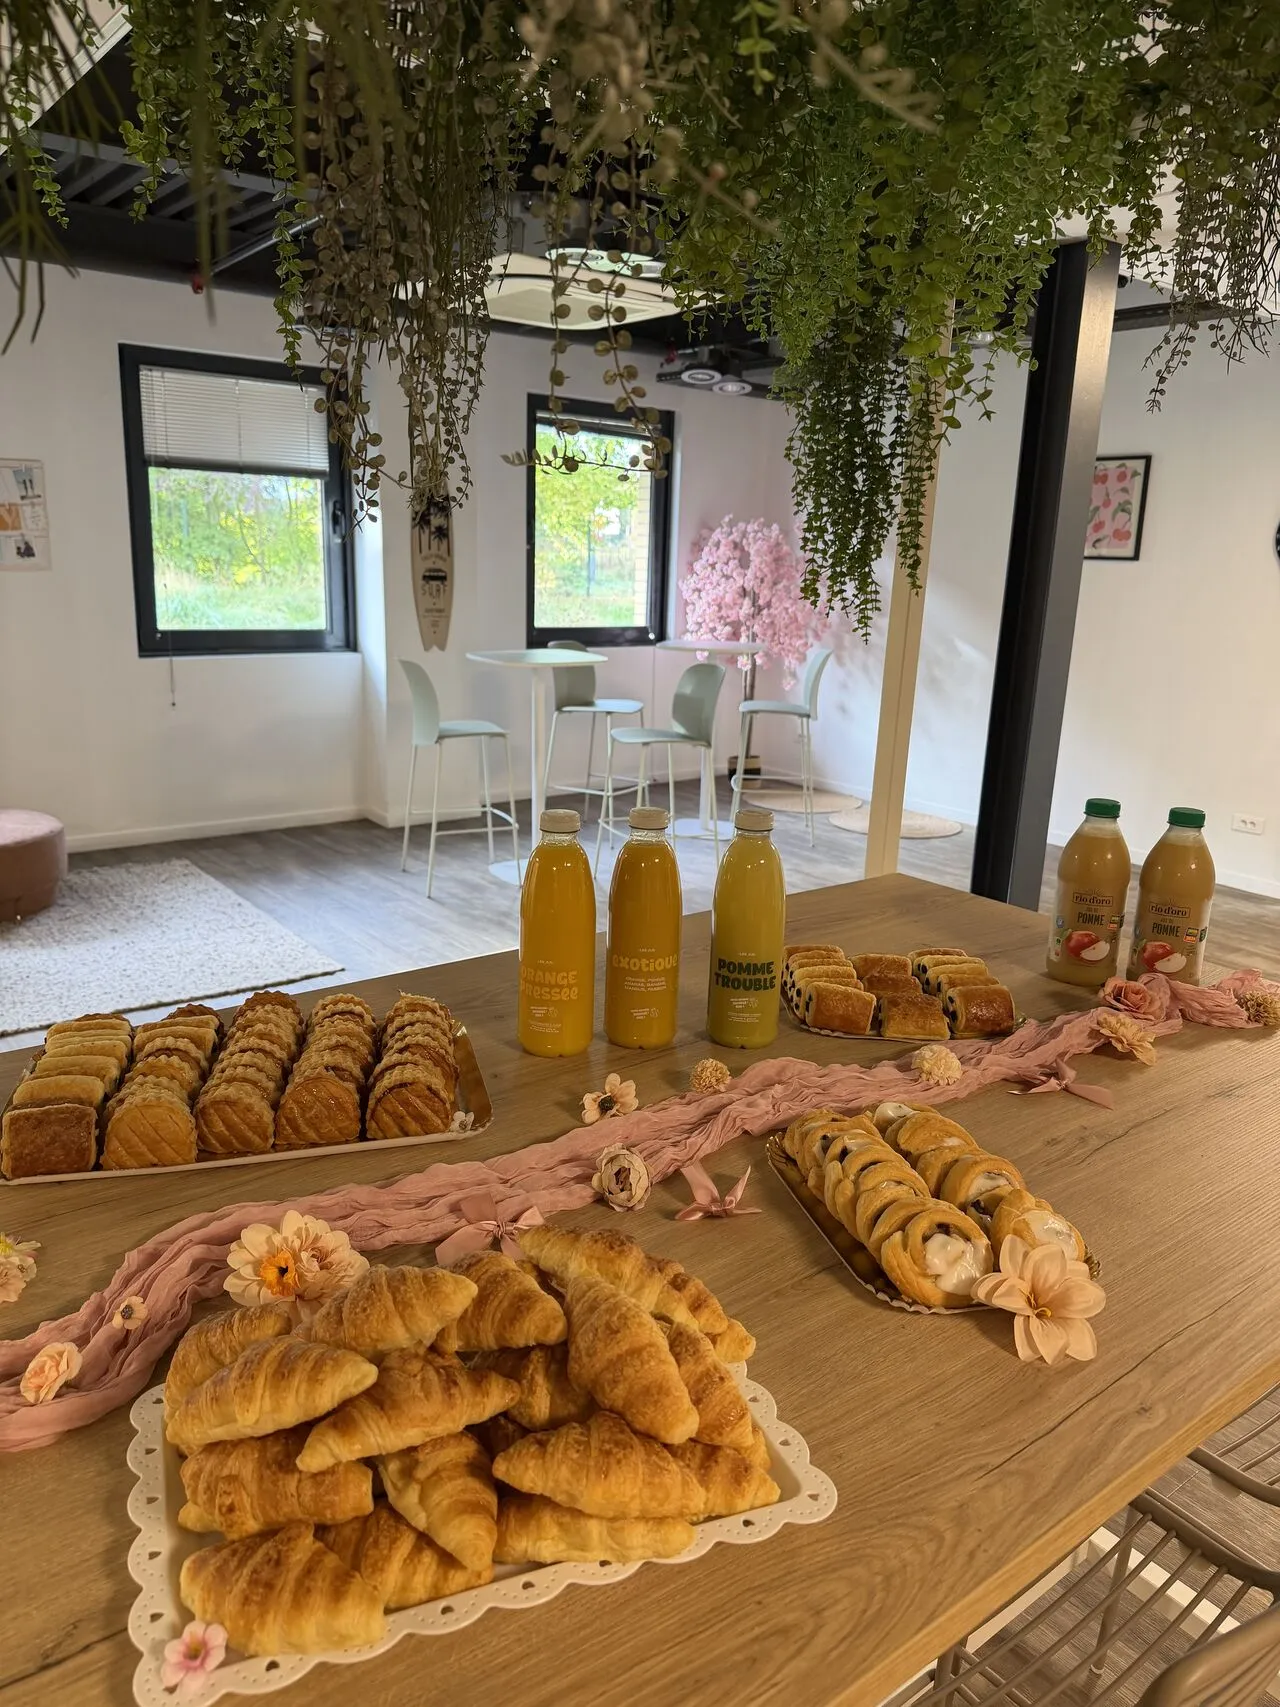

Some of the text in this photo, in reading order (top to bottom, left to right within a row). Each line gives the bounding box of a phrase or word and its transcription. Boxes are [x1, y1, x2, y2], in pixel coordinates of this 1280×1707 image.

[421, 583, 448, 599] SURF
[1075, 894, 1111, 905] rio d'oro
[1151, 904, 1187, 916] rio d'oro
[1077, 912, 1106, 926] POMME
[1151, 922, 1181, 938] POMME
[717, 958, 775, 976] POMME
[521, 965, 578, 986] ORANGE
[714, 972, 777, 992] TROUBLE
